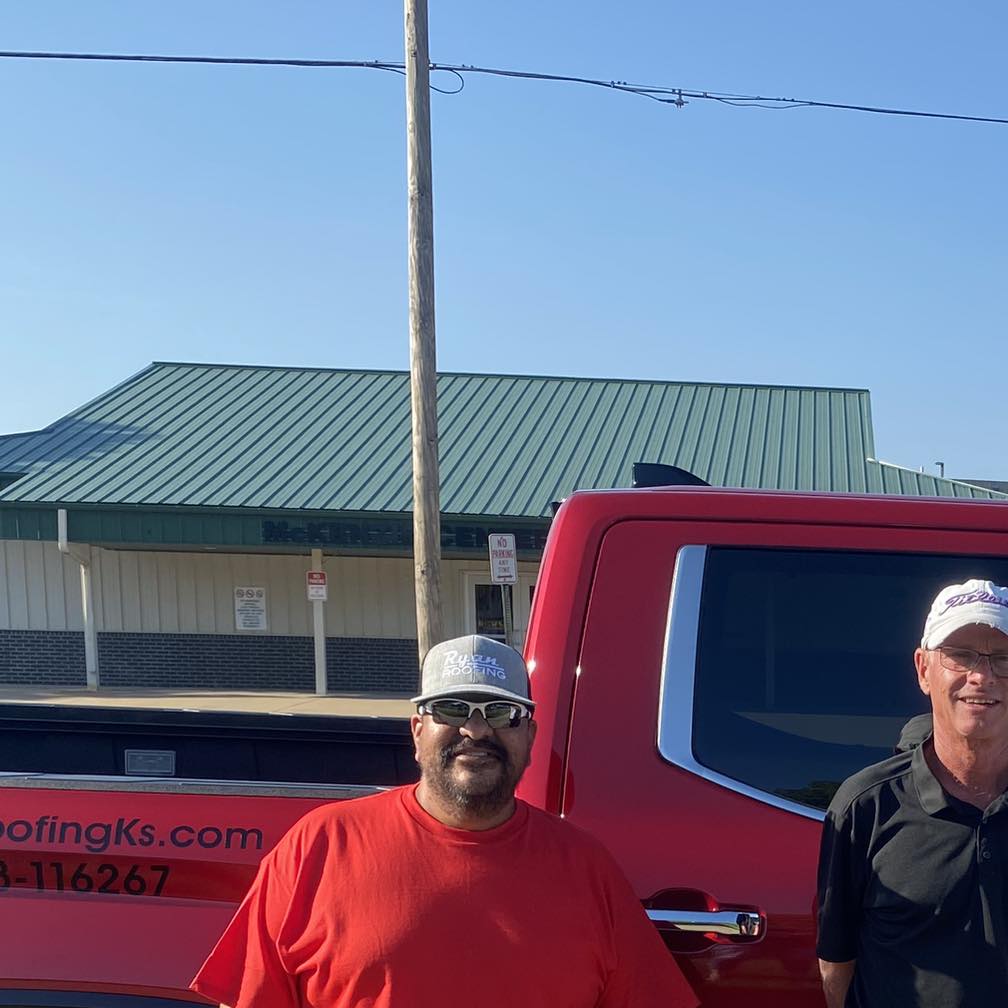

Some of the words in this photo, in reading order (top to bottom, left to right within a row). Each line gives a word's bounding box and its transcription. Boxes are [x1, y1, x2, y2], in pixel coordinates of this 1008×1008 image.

[443, 650, 500, 667] Ryan
[441, 665, 507, 680] ROOFING
[0, 815, 264, 853] ofingKs.com
